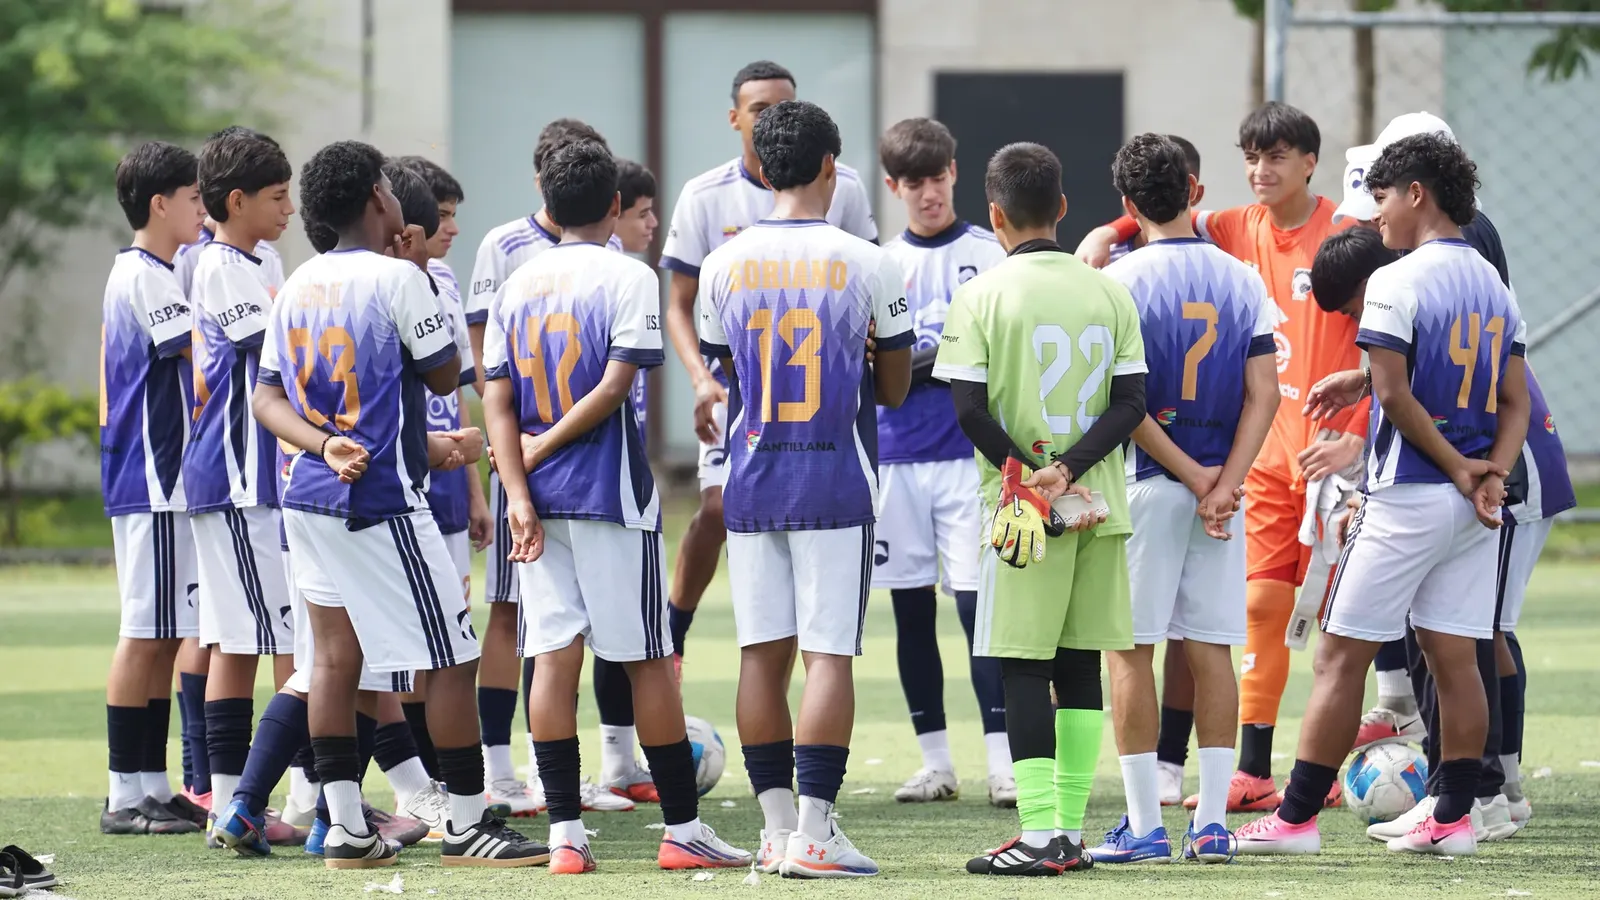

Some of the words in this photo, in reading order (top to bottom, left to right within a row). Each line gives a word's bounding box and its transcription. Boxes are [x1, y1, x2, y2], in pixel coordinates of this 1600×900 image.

[729, 260, 847, 292] SORIANO
[746, 308, 822, 423] 13
[1032, 324, 1115, 435] 22
[1181, 302, 1219, 401] 7
[1449, 312, 1506, 414] 41
[755, 441, 836, 453] SANTILLANA
